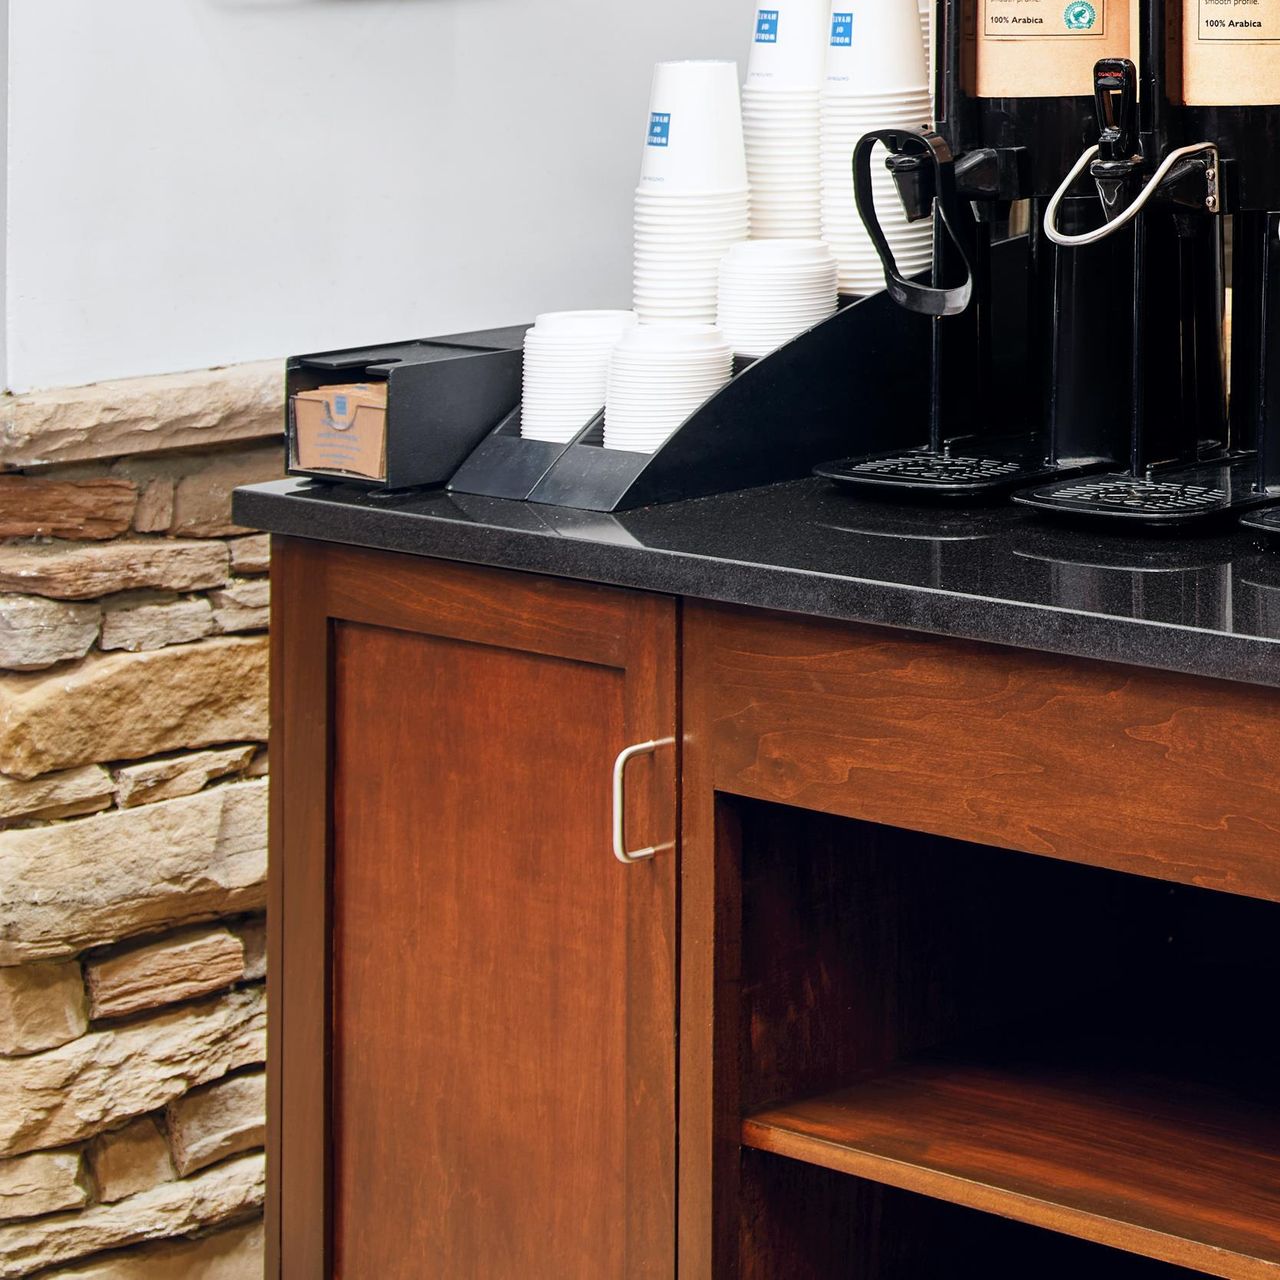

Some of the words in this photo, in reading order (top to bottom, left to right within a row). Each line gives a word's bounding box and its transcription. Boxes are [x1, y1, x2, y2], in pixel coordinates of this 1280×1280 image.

[990, 16, 1010, 24] 100%
[1012, 16, 1044, 24] Arabica
[1205, 20, 1226, 28] 100%
[1228, 20, 1262, 28] Arabica
